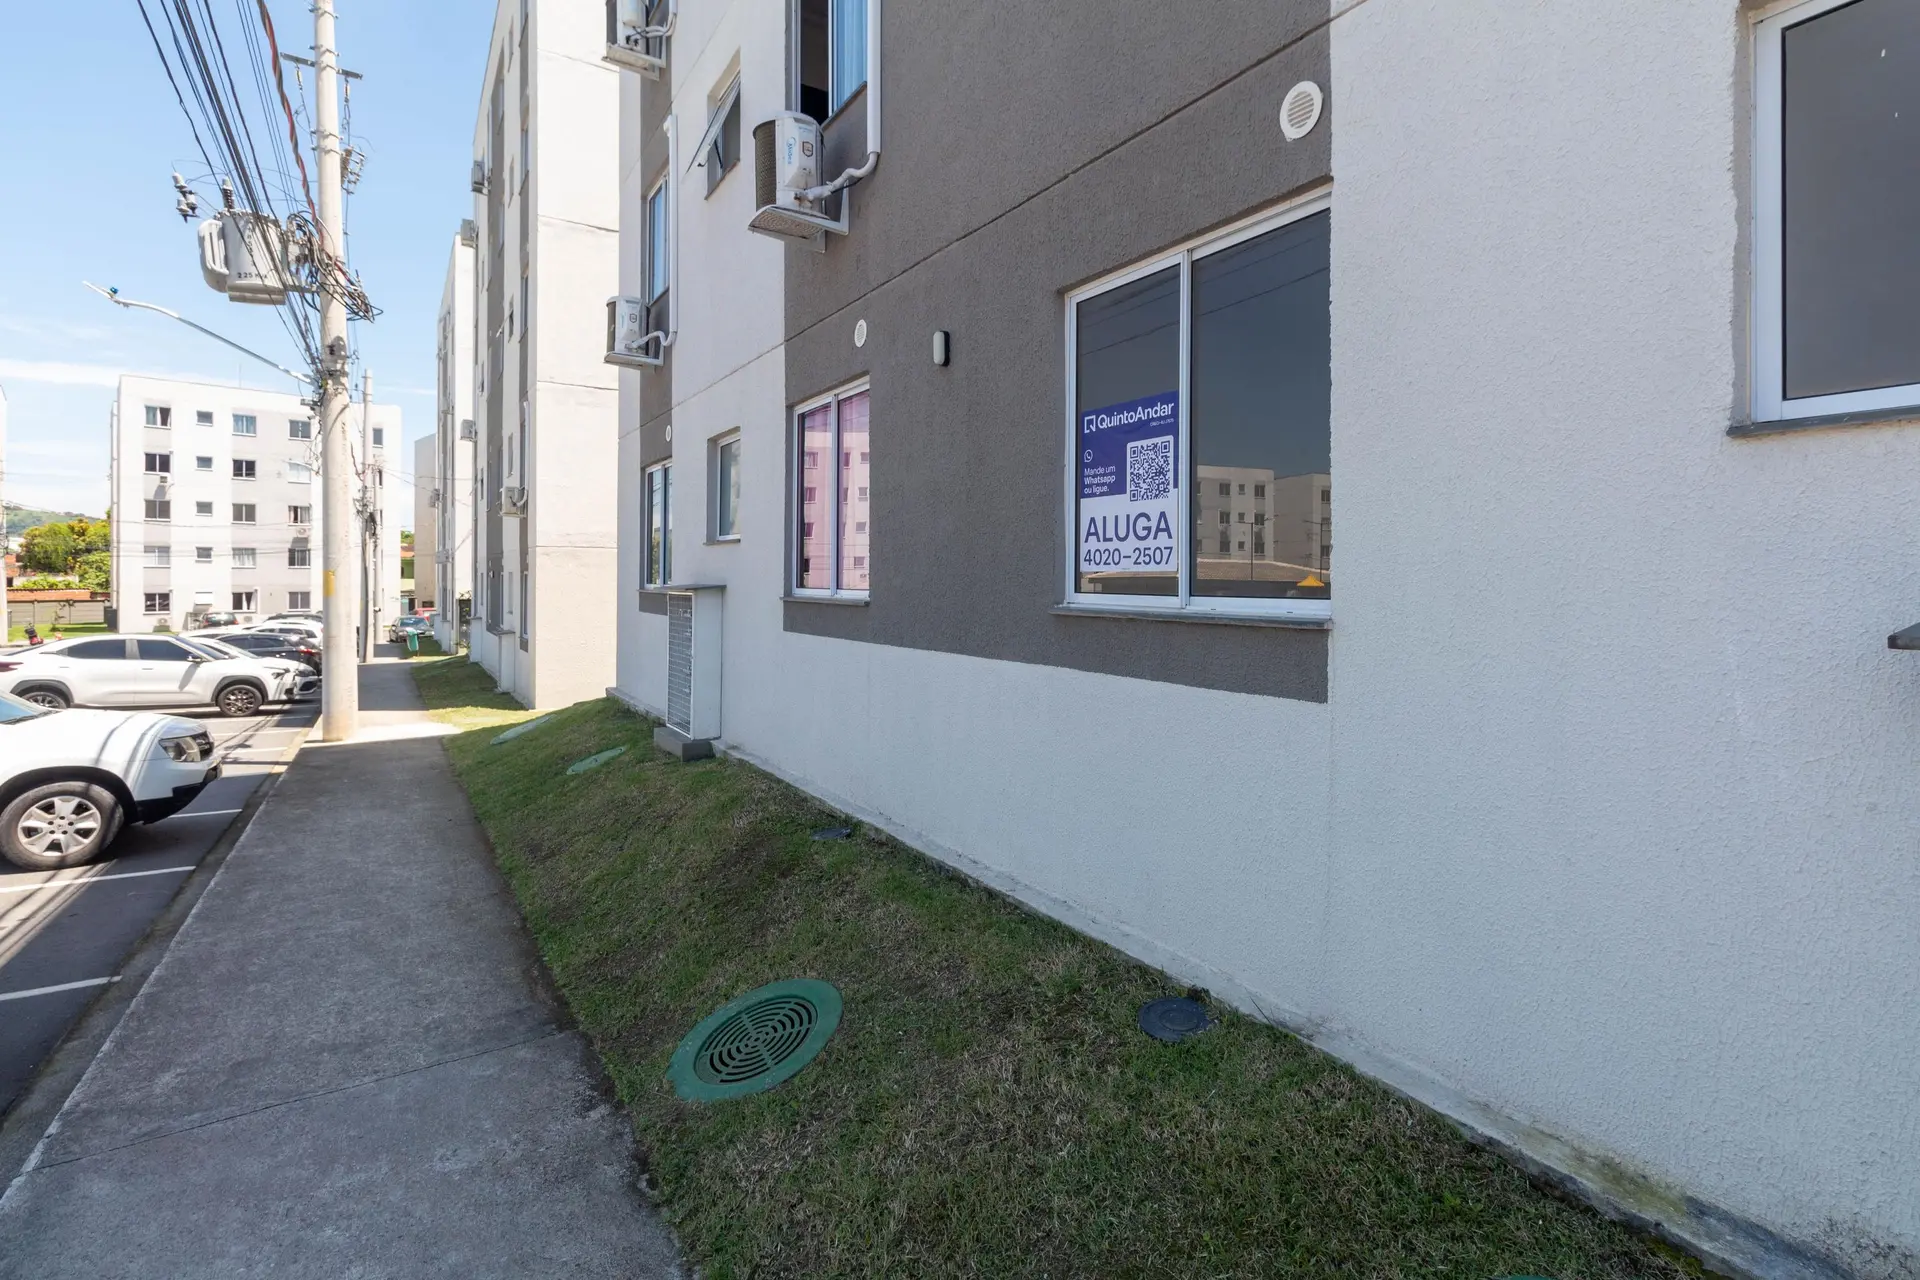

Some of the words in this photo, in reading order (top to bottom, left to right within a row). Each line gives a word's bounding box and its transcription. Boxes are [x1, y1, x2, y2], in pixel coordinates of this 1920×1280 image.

[1097, 402, 1175, 429] QuintoAndar
[1084, 466, 1105, 476] Mande
[1105, 465, 1116, 473] um
[1084, 475, 1116, 485] Whatsapp
[1092, 485, 1110, 495] ligue.
[1084, 511, 1173, 543] ALUGA
[1083, 546, 1173, 566] 4020-2507
